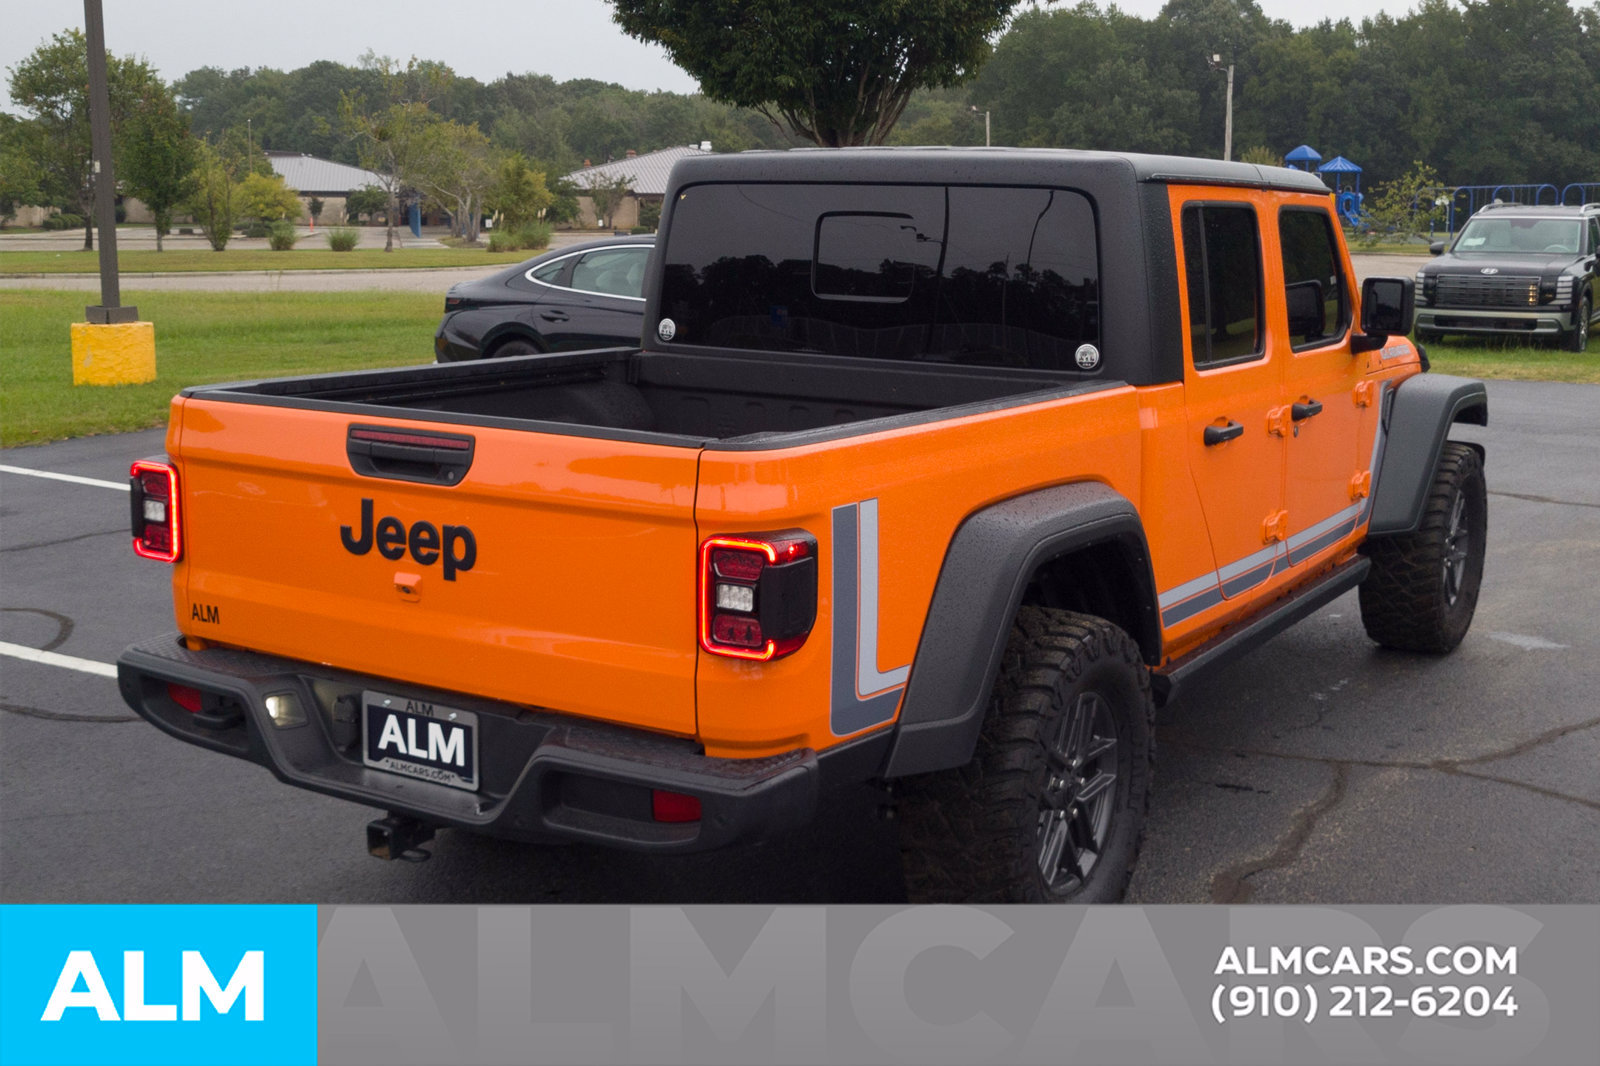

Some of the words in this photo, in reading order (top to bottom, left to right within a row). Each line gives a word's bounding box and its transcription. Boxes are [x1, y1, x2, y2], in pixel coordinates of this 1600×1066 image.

[340, 498, 477, 581] Jeep
[191, 603, 220, 625] ALM
[405, 700, 434, 716] ALM
[378, 714, 465, 767] ALM
